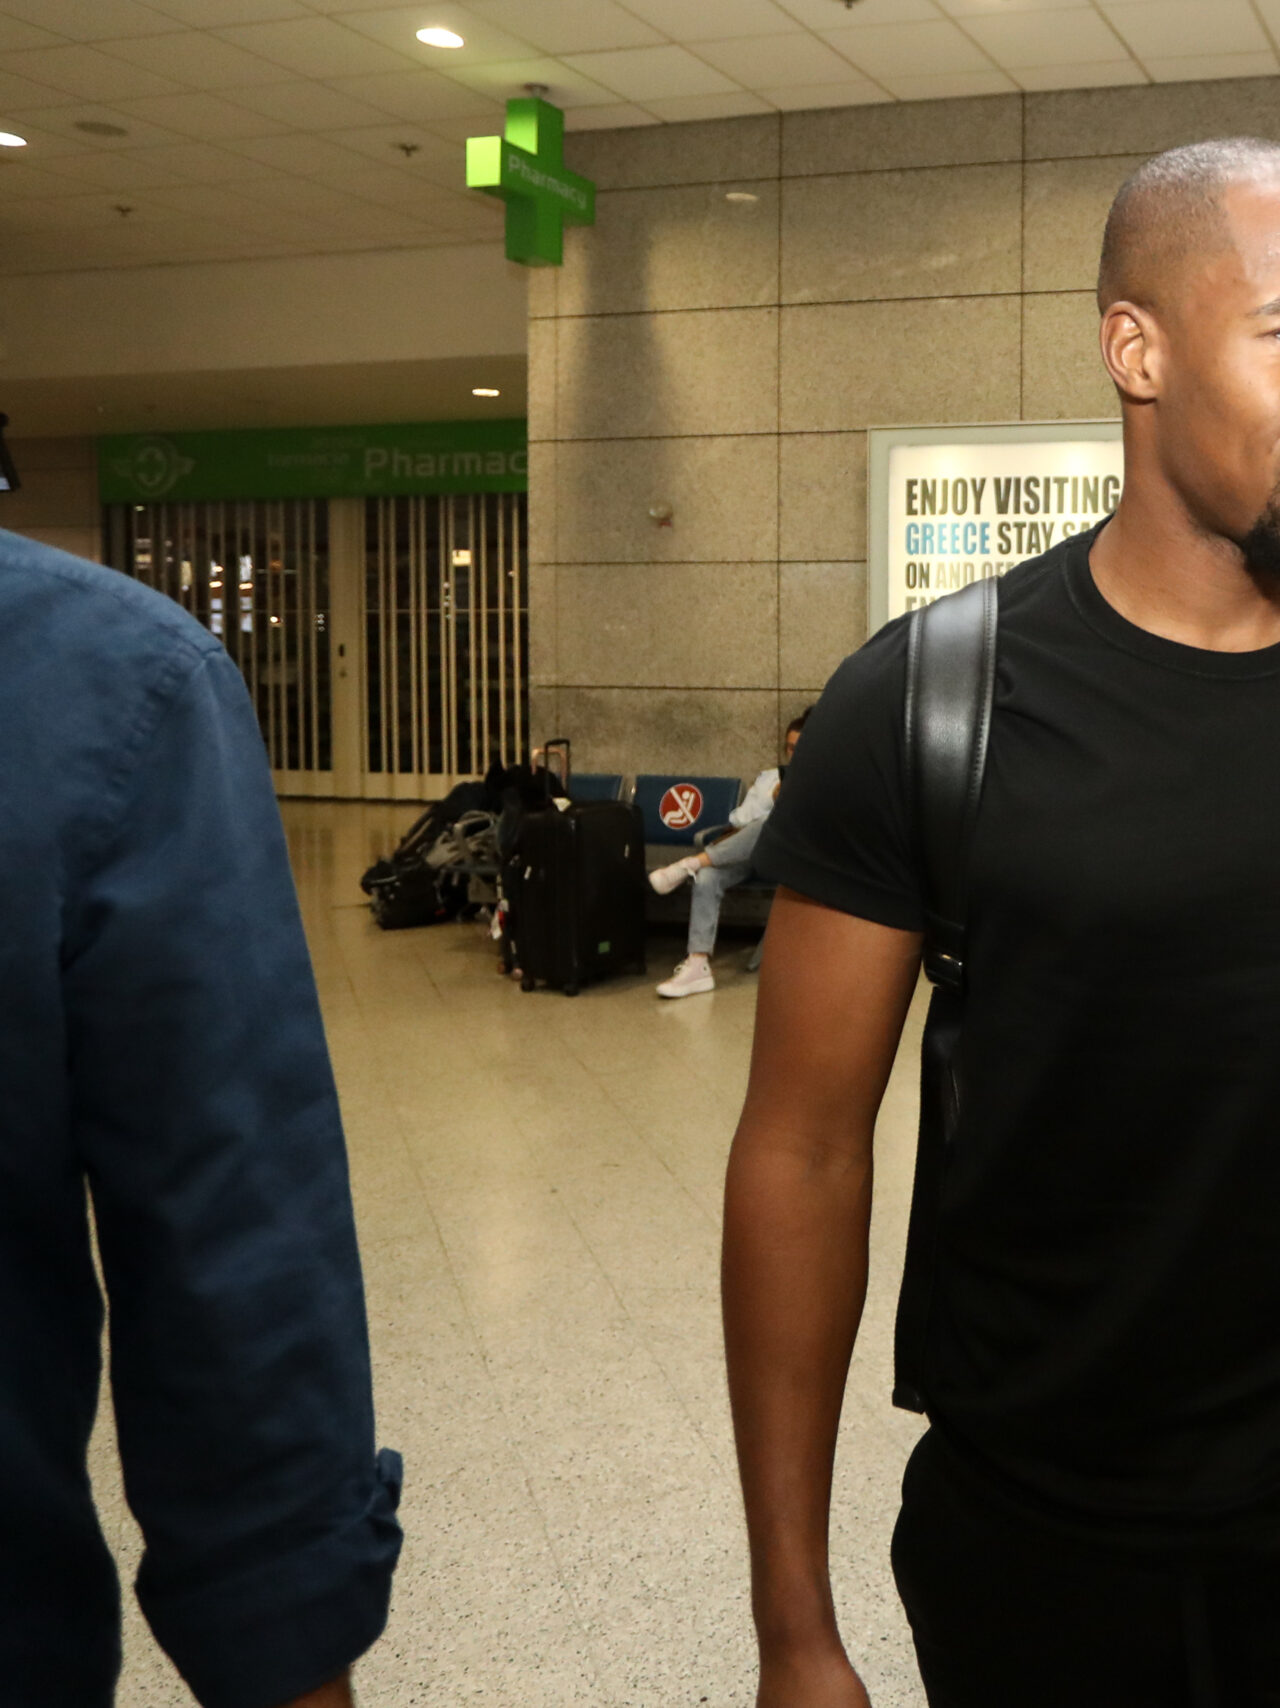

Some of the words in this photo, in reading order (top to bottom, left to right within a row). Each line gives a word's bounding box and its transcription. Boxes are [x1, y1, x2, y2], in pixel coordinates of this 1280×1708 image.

[508, 154, 587, 210] Pharmacy
[906, 478, 986, 516] ENJOY
[994, 475, 1120, 515] VISITING
[906, 522, 990, 555] GREECE
[997, 521, 1054, 554] STAY
[906, 562, 930, 589] ON
[935, 562, 974, 589] AND
